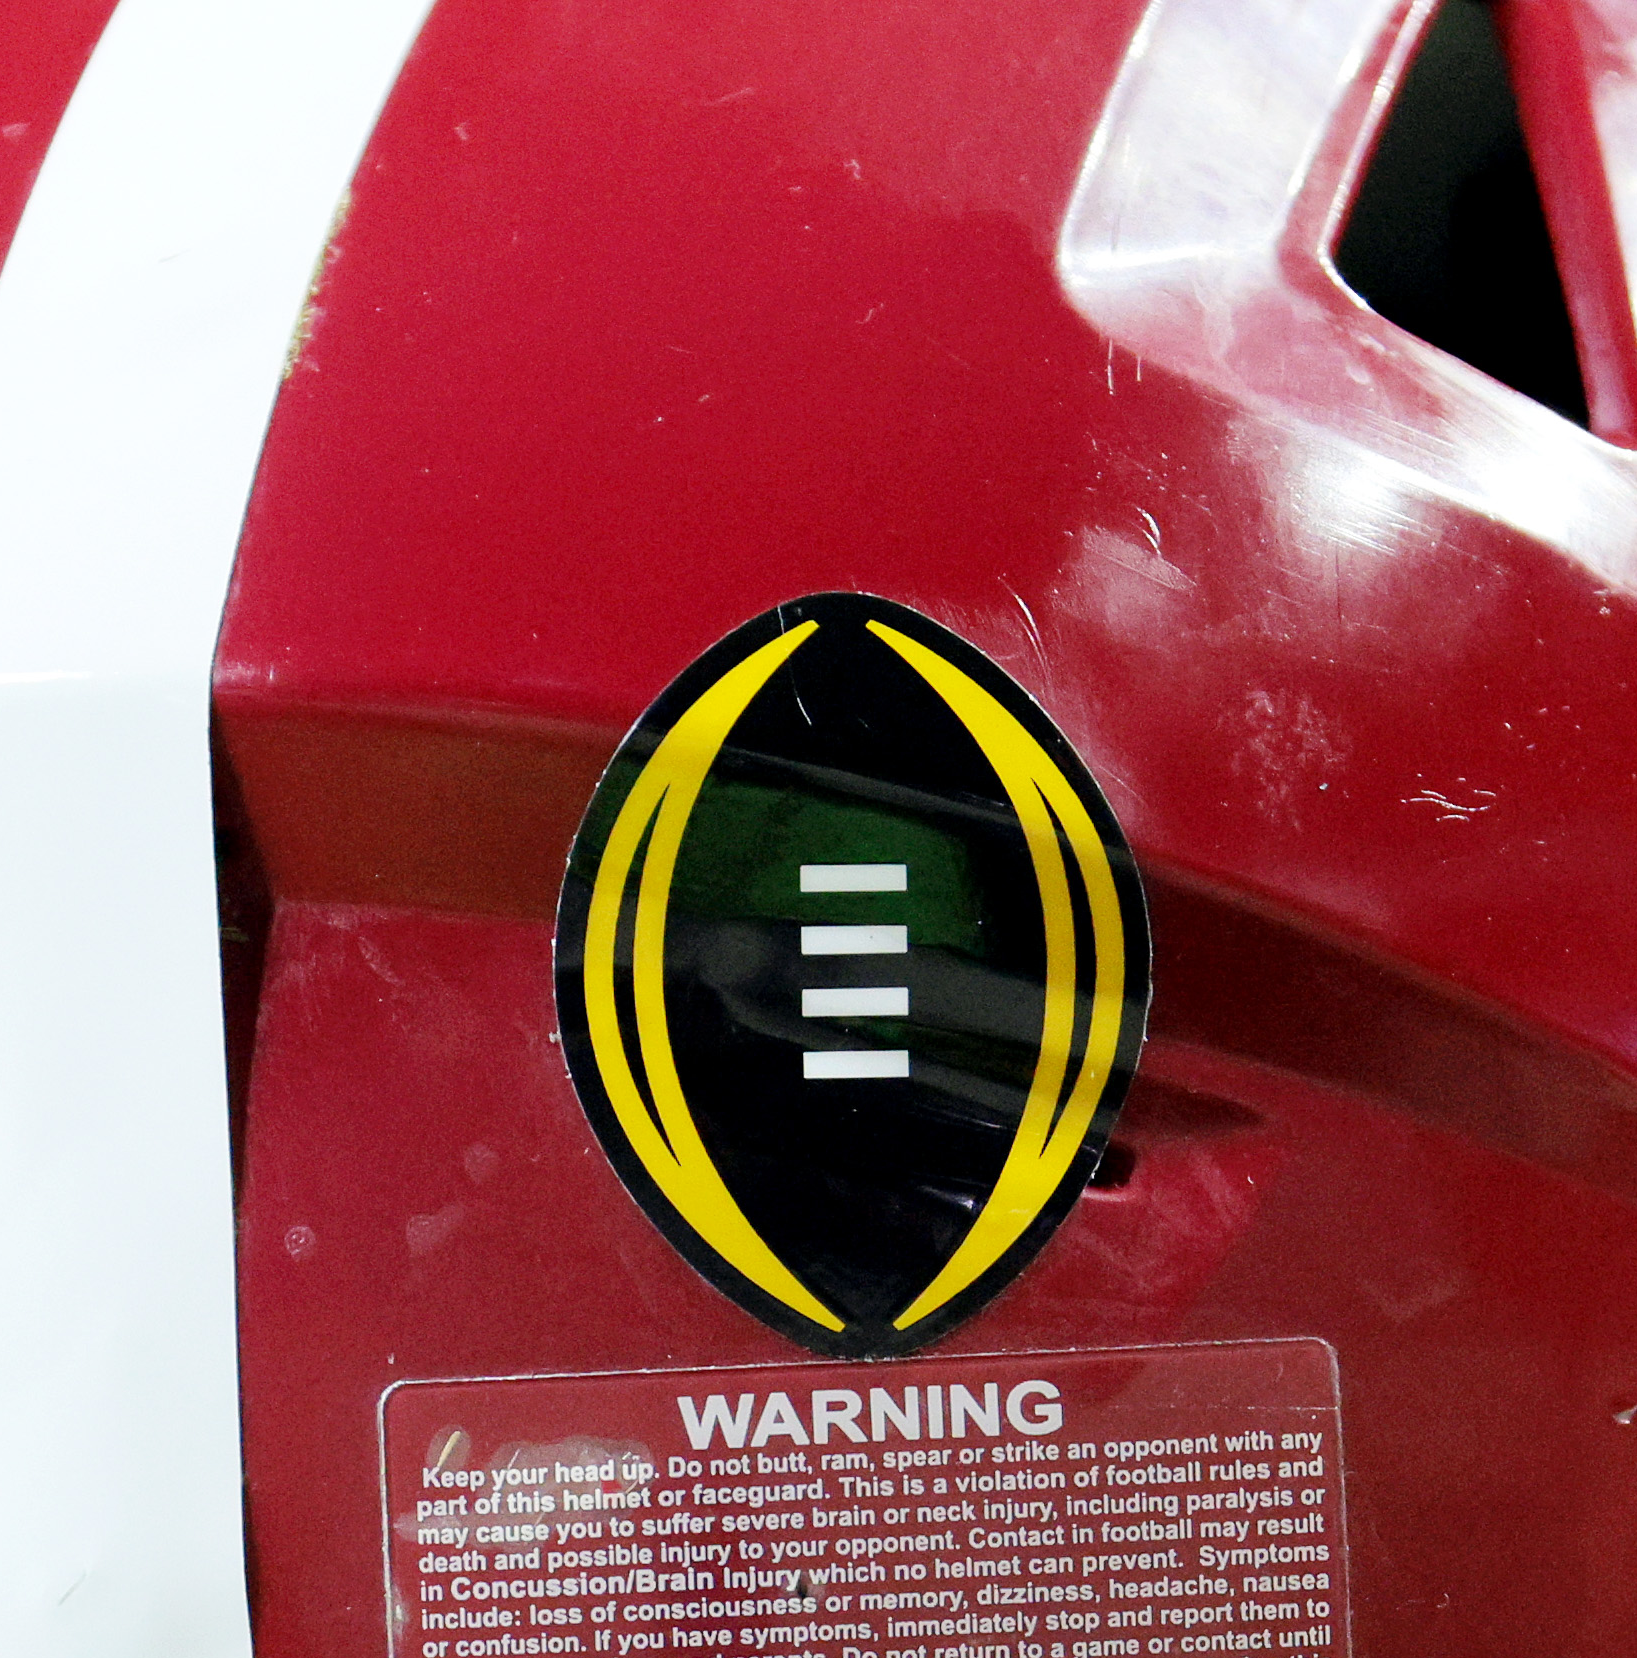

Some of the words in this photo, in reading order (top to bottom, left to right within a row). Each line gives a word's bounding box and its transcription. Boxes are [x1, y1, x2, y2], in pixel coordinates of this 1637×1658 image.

[676, 1379, 1063, 1451] WARNING
[416, 1494, 468, 1522] part
[474, 1492, 502, 1515] of
[506, 1490, 556, 1514] this
[563, 1487, 652, 1512] helmet
[657, 1489, 687, 1507] or
[691, 1478, 831, 1509] faceguard.
[838, 1475, 895, 1499] This
[902, 1474, 925, 1496] is
[932, 1477, 948, 1494] a
[954, 1468, 1066, 1493] violation
[1073, 1465, 1100, 1488] of
[1105, 1461, 1202, 1486] football
[1209, 1459, 1271, 1482] rules
[1278, 1455, 1324, 1479] and
[422, 1466, 485, 1492] Keep
[491, 1467, 549, 1492] your
[554, 1458, 615, 1484] head
[621, 1462, 660, 1485] up.
[668, 1456, 703, 1479] Do
[709, 1454, 751, 1476] not
[757, 1451, 813, 1475] butt,
[821, 1452, 875, 1473] ram,
[882, 1448, 953, 1473] spear
[958, 1447, 985, 1465] or
[991, 1440, 1060, 1464] strike
[1067, 1442, 1097, 1460] an
[1103, 1433, 1219, 1463] opponent
[1224, 1430, 1274, 1453] with
[1280, 1432, 1323, 1454] any
[417, 1527, 469, 1549] may
[475, 1524, 550, 1544] cause
[555, 1521, 602, 1545] you
[608, 1516, 635, 1538] to
[641, 1512, 716, 1536] suffer
[721, 1512, 805, 1533] severe
[812, 1504, 876, 1528] brain
[883, 1507, 911, 1525] or
[916, 1500, 977, 1523] neck
[983, 1498, 1058, 1525] injury,
[1066, 1491, 1179, 1517] including
[1186, 1485, 1294, 1516] paralysis
[1300, 1488, 1326, 1506] or
[418, 1550, 487, 1574] death
[493, 1547, 540, 1571] and
[547, 1542, 653, 1574] possible
[660, 1540, 732, 1568] injury
[738, 1539, 764, 1560] to
[770, 1539, 829, 1564] your
[835, 1530, 961, 1560] opponent.
[968, 1525, 1065, 1549] Contact
[1071, 1523, 1094, 1545] in
[1100, 1517, 1193, 1543] football
[1199, 1520, 1250, 1543] may
[1257, 1512, 1325, 1536] result
[420, 1580, 444, 1602] in
[450, 1566, 715, 1601] Concussion/Brain
[723, 1565, 802, 1594] Injury
[808, 1560, 886, 1586] which
[894, 1563, 927, 1581] no
[934, 1555, 1022, 1579] helmet
[1028, 1556, 1074, 1575] can
[1082, 1548, 1184, 1578] prevent.
[1199, 1543, 1330, 1571] Symptoms
[421, 1605, 521, 1631] include:
[529, 1603, 583, 1626] loss
[590, 1600, 617, 1624] of
[622, 1596, 818, 1622] consciousness
[824, 1595, 853, 1613] or
[859, 1590, 969, 1613] memory,
[976, 1581, 1101, 1605] dizziness,
[1108, 1573, 1235, 1599] headache,
[1242, 1572, 1330, 1593] nausea
[422, 1640, 449, 1658] or
[455, 1632, 587, 1658] confusion.
[594, 1629, 612, 1652] If
[617, 1632, 665, 1656] you
[671, 1626, 733, 1648] have
[739, 1621, 879, 1650] symptoms,
[887, 1610, 1038, 1638] immediately
[1045, 1610, 1100, 1634] stop
[1107, 1604, 1153, 1628] and
[1160, 1602, 1234, 1629] report
[1239, 1600, 1300, 1622] them
[1306, 1598, 1330, 1619] to
[1050, 1642, 1065, 1658] a
[1147, 1637, 1174, 1654] or
[1180, 1628, 1272, 1653] contact
[1278, 1624, 1331, 1648] until
